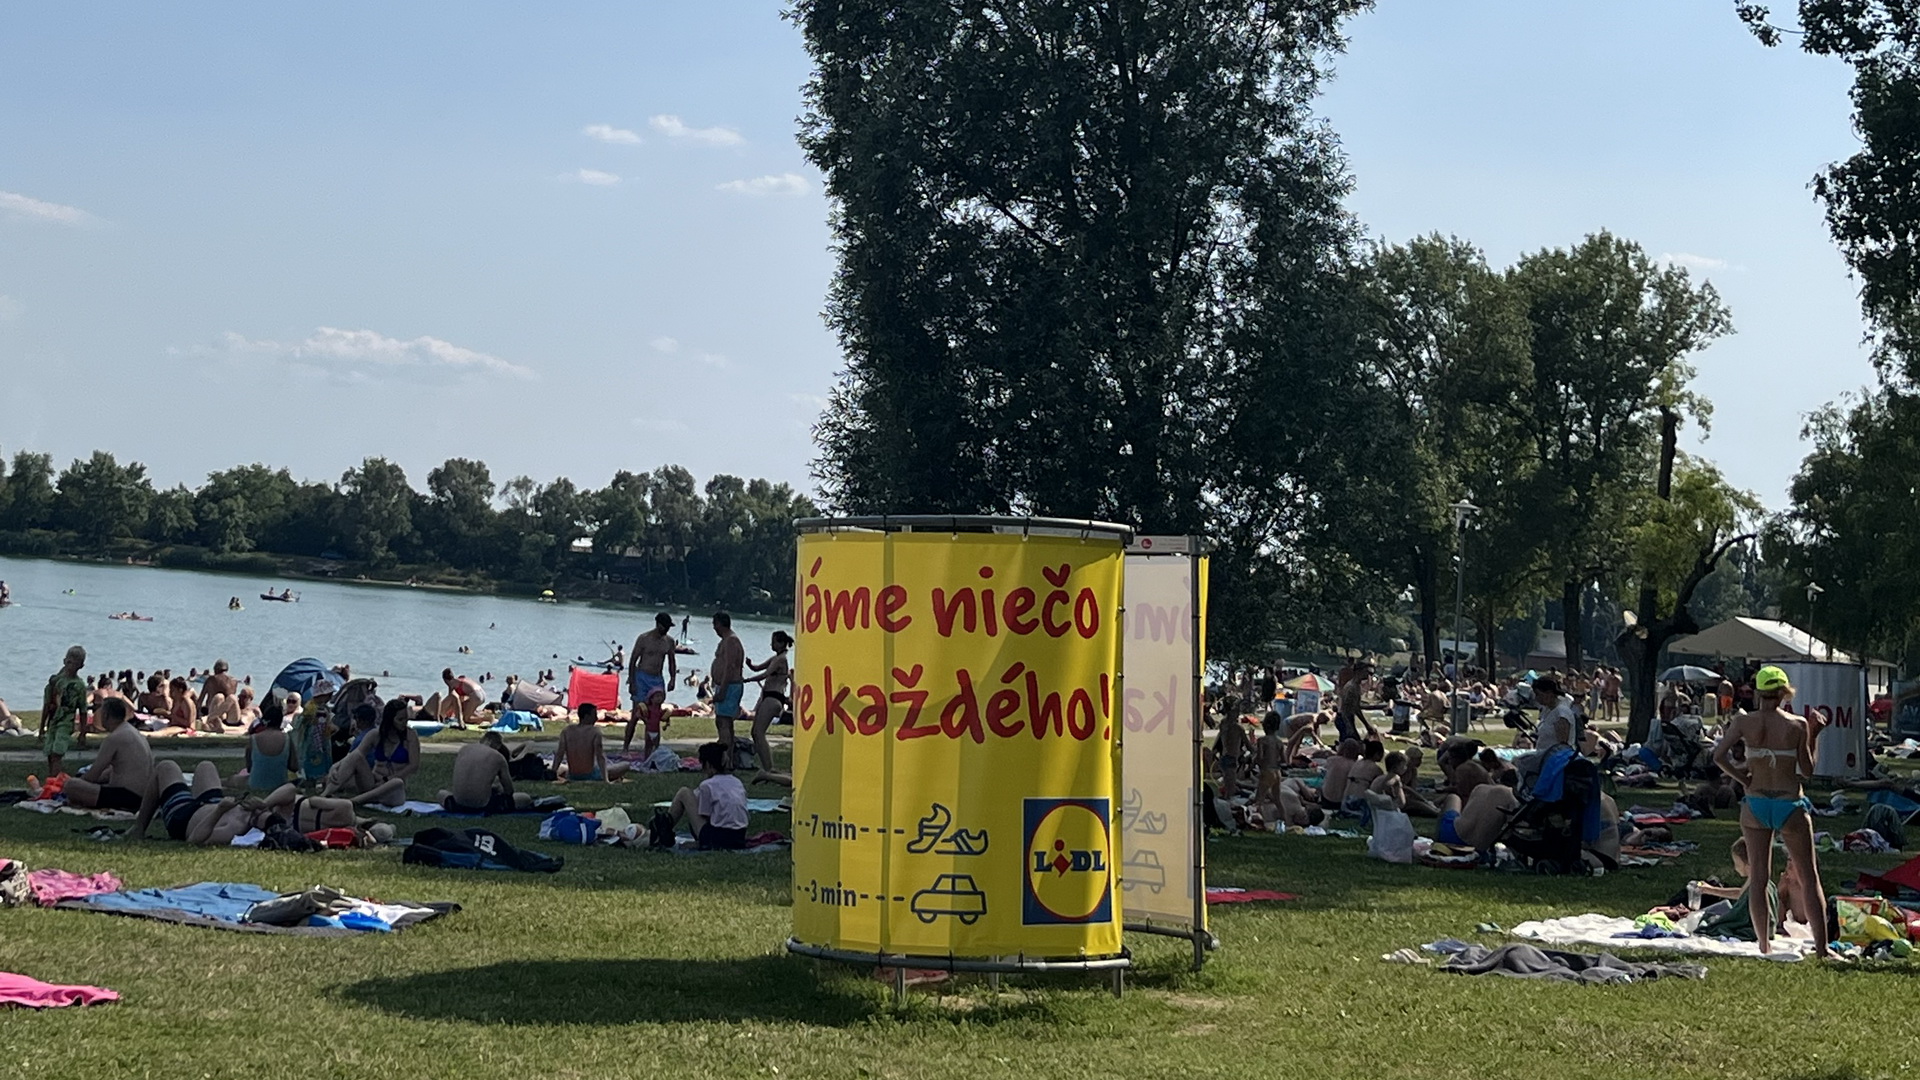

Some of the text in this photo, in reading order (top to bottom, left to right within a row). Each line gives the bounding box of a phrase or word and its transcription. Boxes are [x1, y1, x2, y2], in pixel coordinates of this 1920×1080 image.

[932, 563, 1099, 639] niečo
[824, 662, 1109, 744] každého!
[822, 815, 857, 841] min
[821, 881, 857, 907] min
